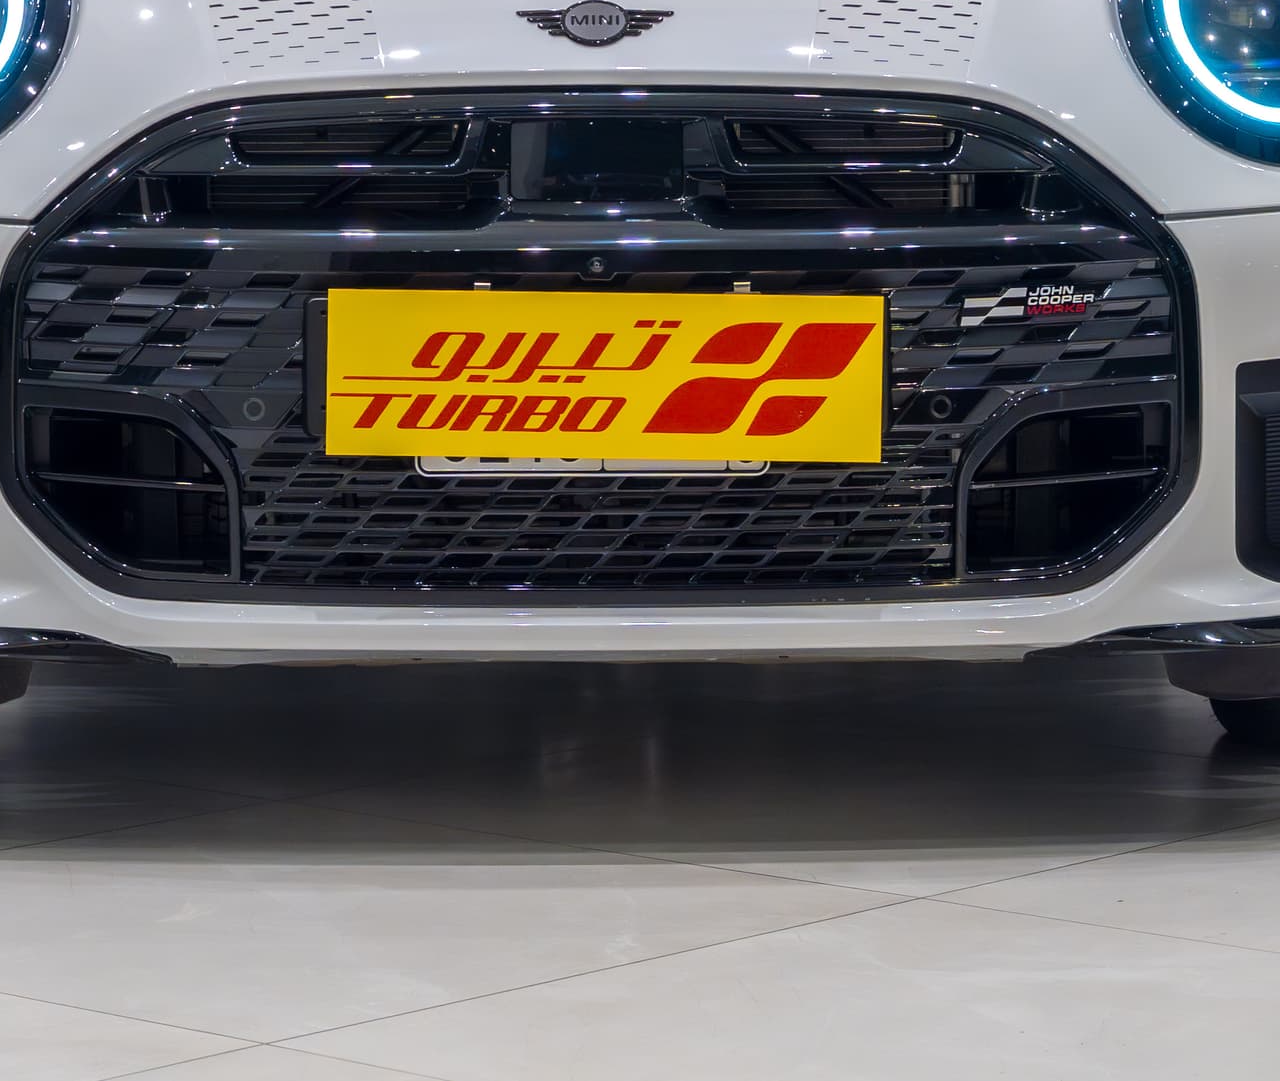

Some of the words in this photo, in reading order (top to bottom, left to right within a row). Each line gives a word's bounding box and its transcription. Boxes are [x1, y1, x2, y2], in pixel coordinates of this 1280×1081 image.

[570, 14, 620, 27] MINI
[1028, 285, 1075, 297] JOHN
[1027, 293, 1095, 307] COOPER
[1026, 303, 1087, 316] WORKS
[341, 319, 684, 384] تيربو
[329, 392, 628, 434] TURBO
